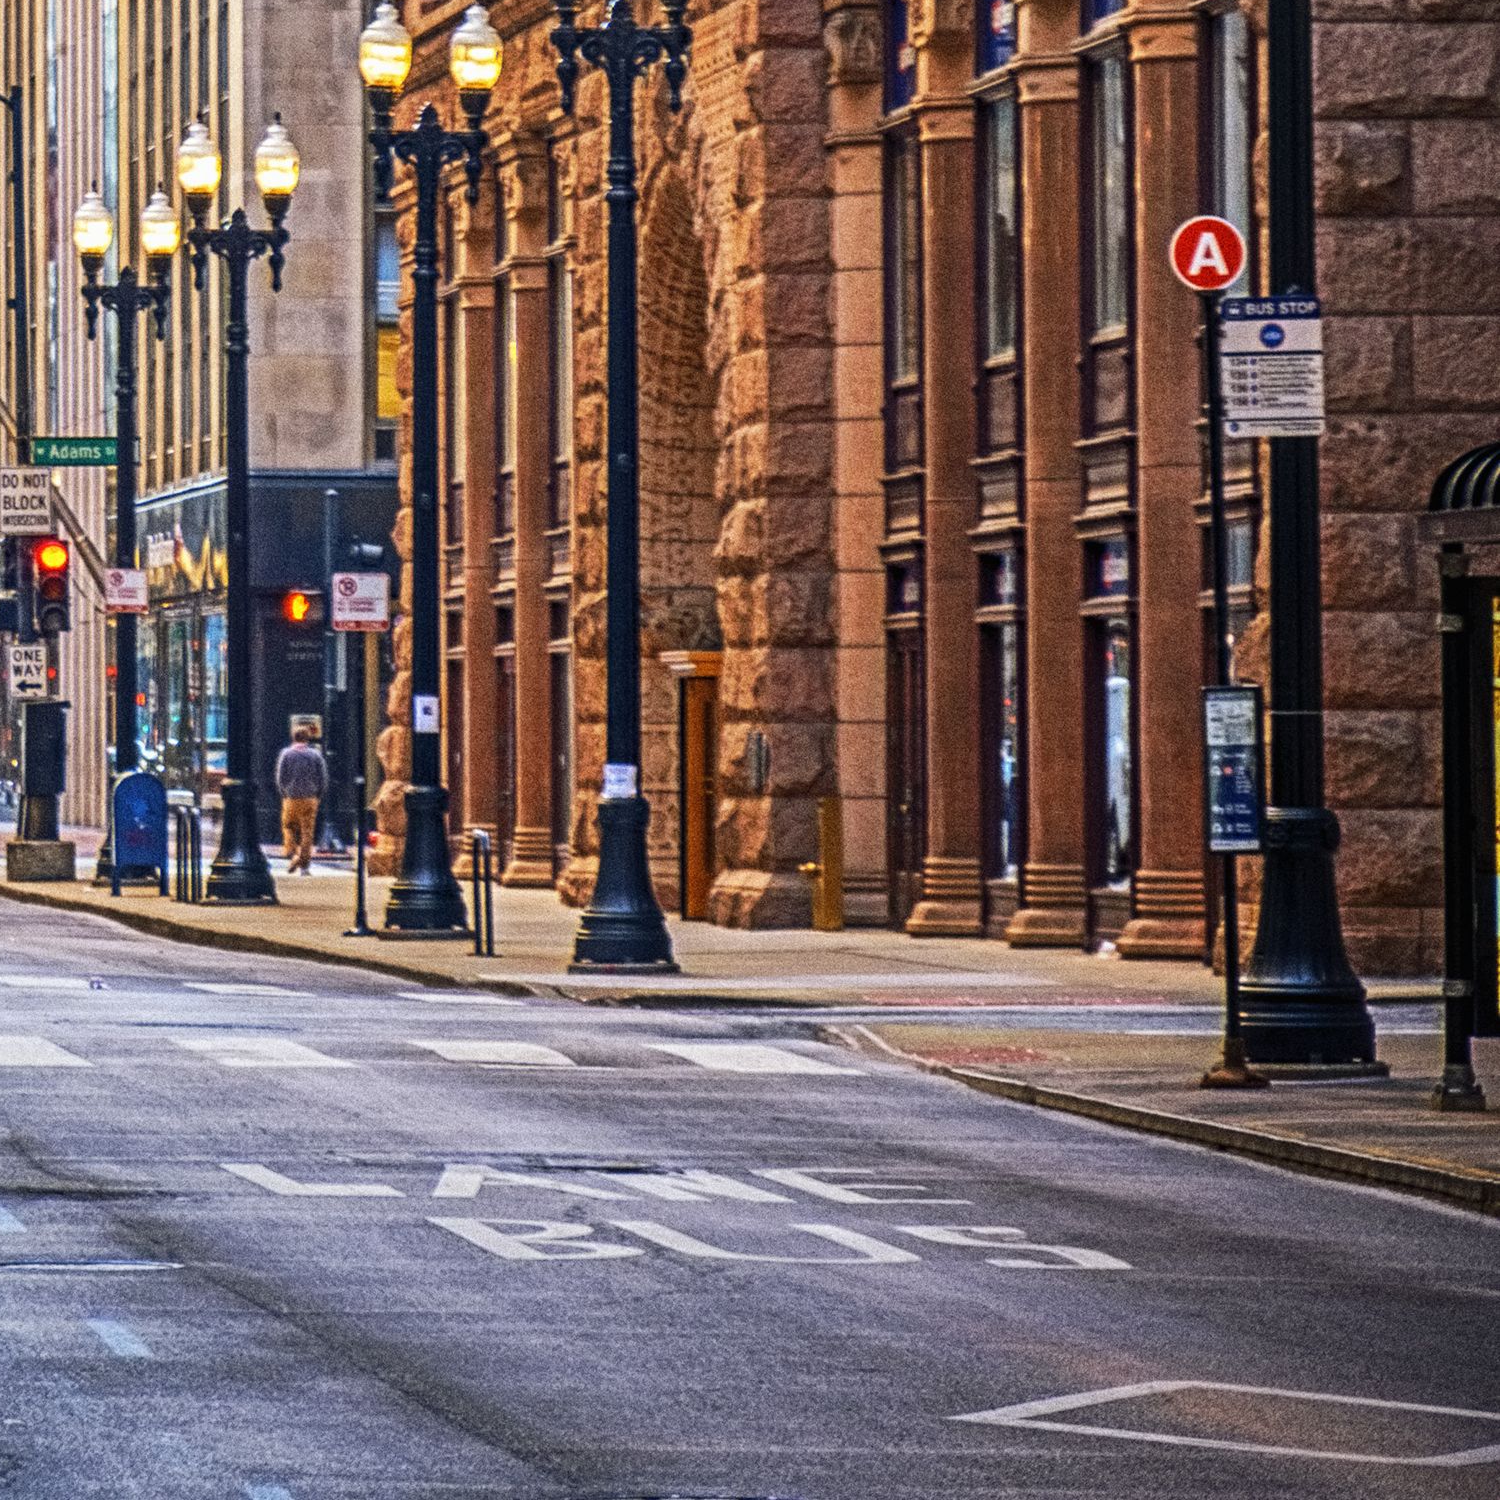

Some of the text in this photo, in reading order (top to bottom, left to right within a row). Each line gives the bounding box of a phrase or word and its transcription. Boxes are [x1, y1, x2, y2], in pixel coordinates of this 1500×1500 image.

[1188, 231, 1230, 276] A
[1245, 301, 1317, 315] BUS STOP
[49, 443, 102, 460] Adams
[2, 474, 48, 488] DO NOT
[3, 495, 47, 510] BLOCK
[3, 515, 49, 526] INTERSECTION
[12, 650, 43, 662] ONE
[12, 665, 43, 677] WAY
[219, 1161, 976, 1206] LANE
[424, 1215, 1136, 1271] BUS
